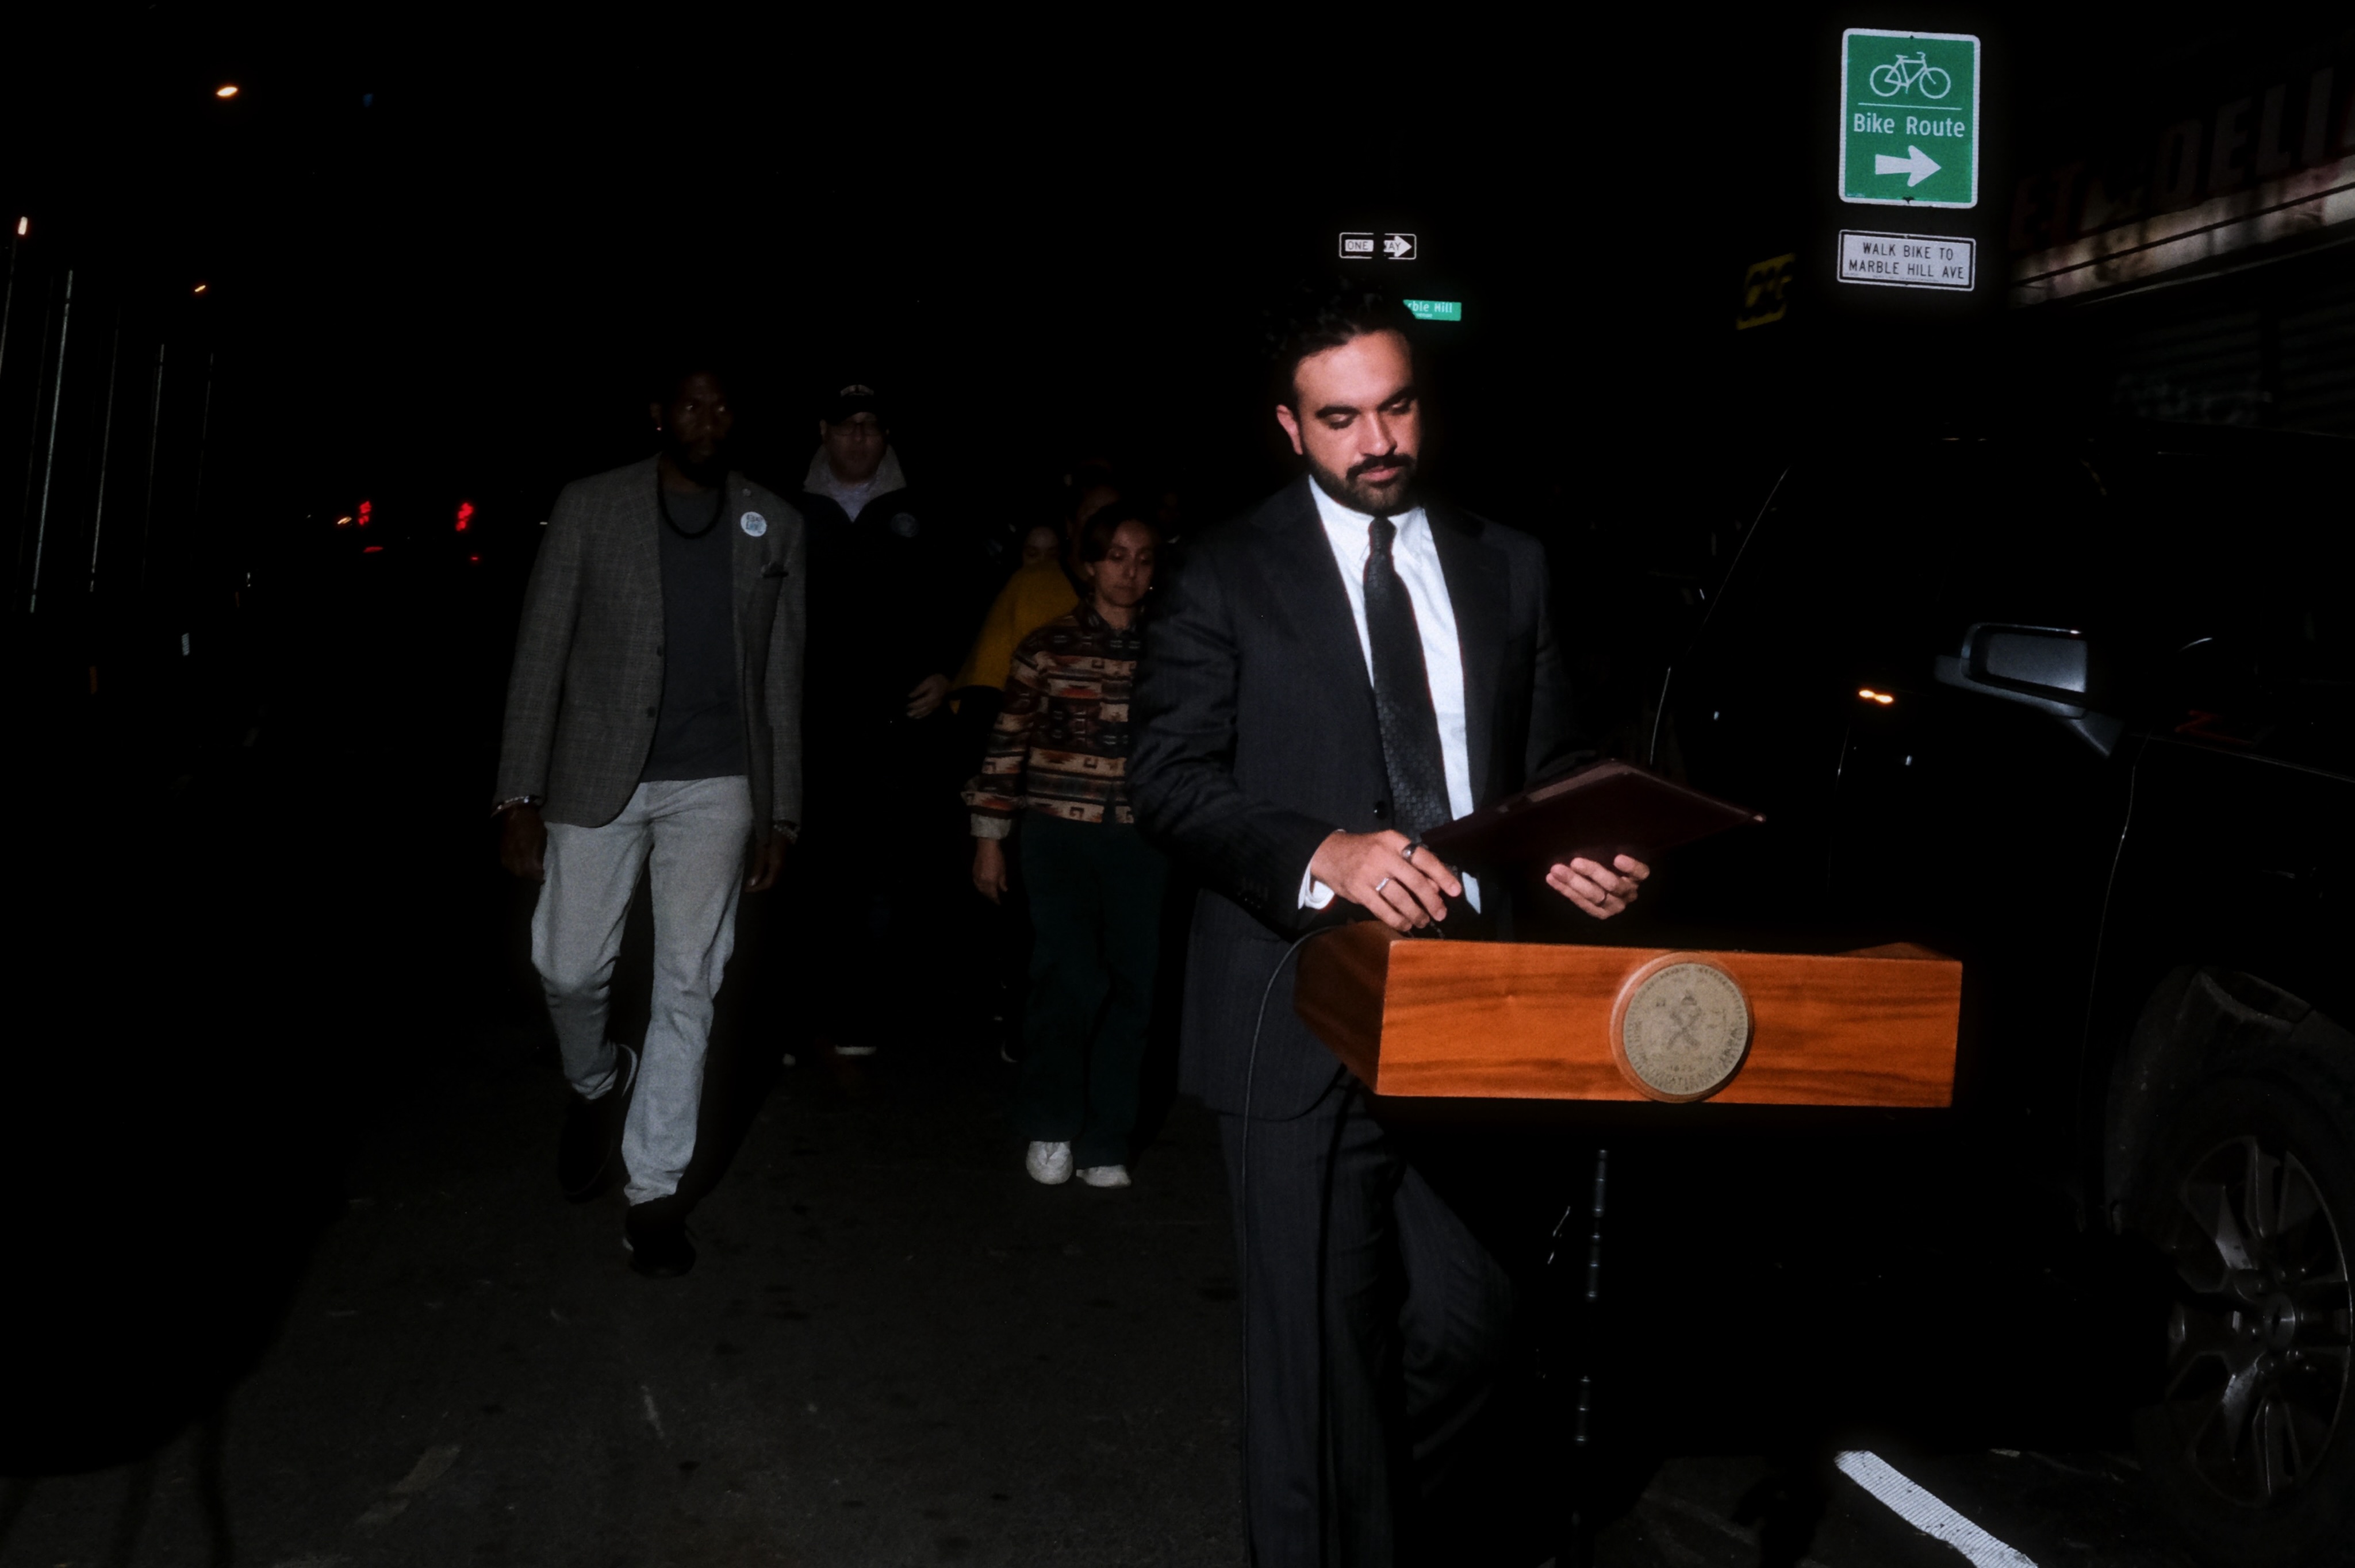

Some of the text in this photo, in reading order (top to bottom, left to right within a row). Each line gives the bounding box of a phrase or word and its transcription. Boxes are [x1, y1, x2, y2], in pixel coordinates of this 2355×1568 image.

[1853, 113, 1965, 137] Bike Route
[1347, 241, 1368, 250] ONE
[1863, 242, 1954, 261] WALK BIKE TO
[1848, 259, 1900, 275] MARBLE
[1907, 263, 1934, 277] HILL
[1942, 266, 1965, 279] AVE
[1407, 301, 1453, 313] rble Hill
